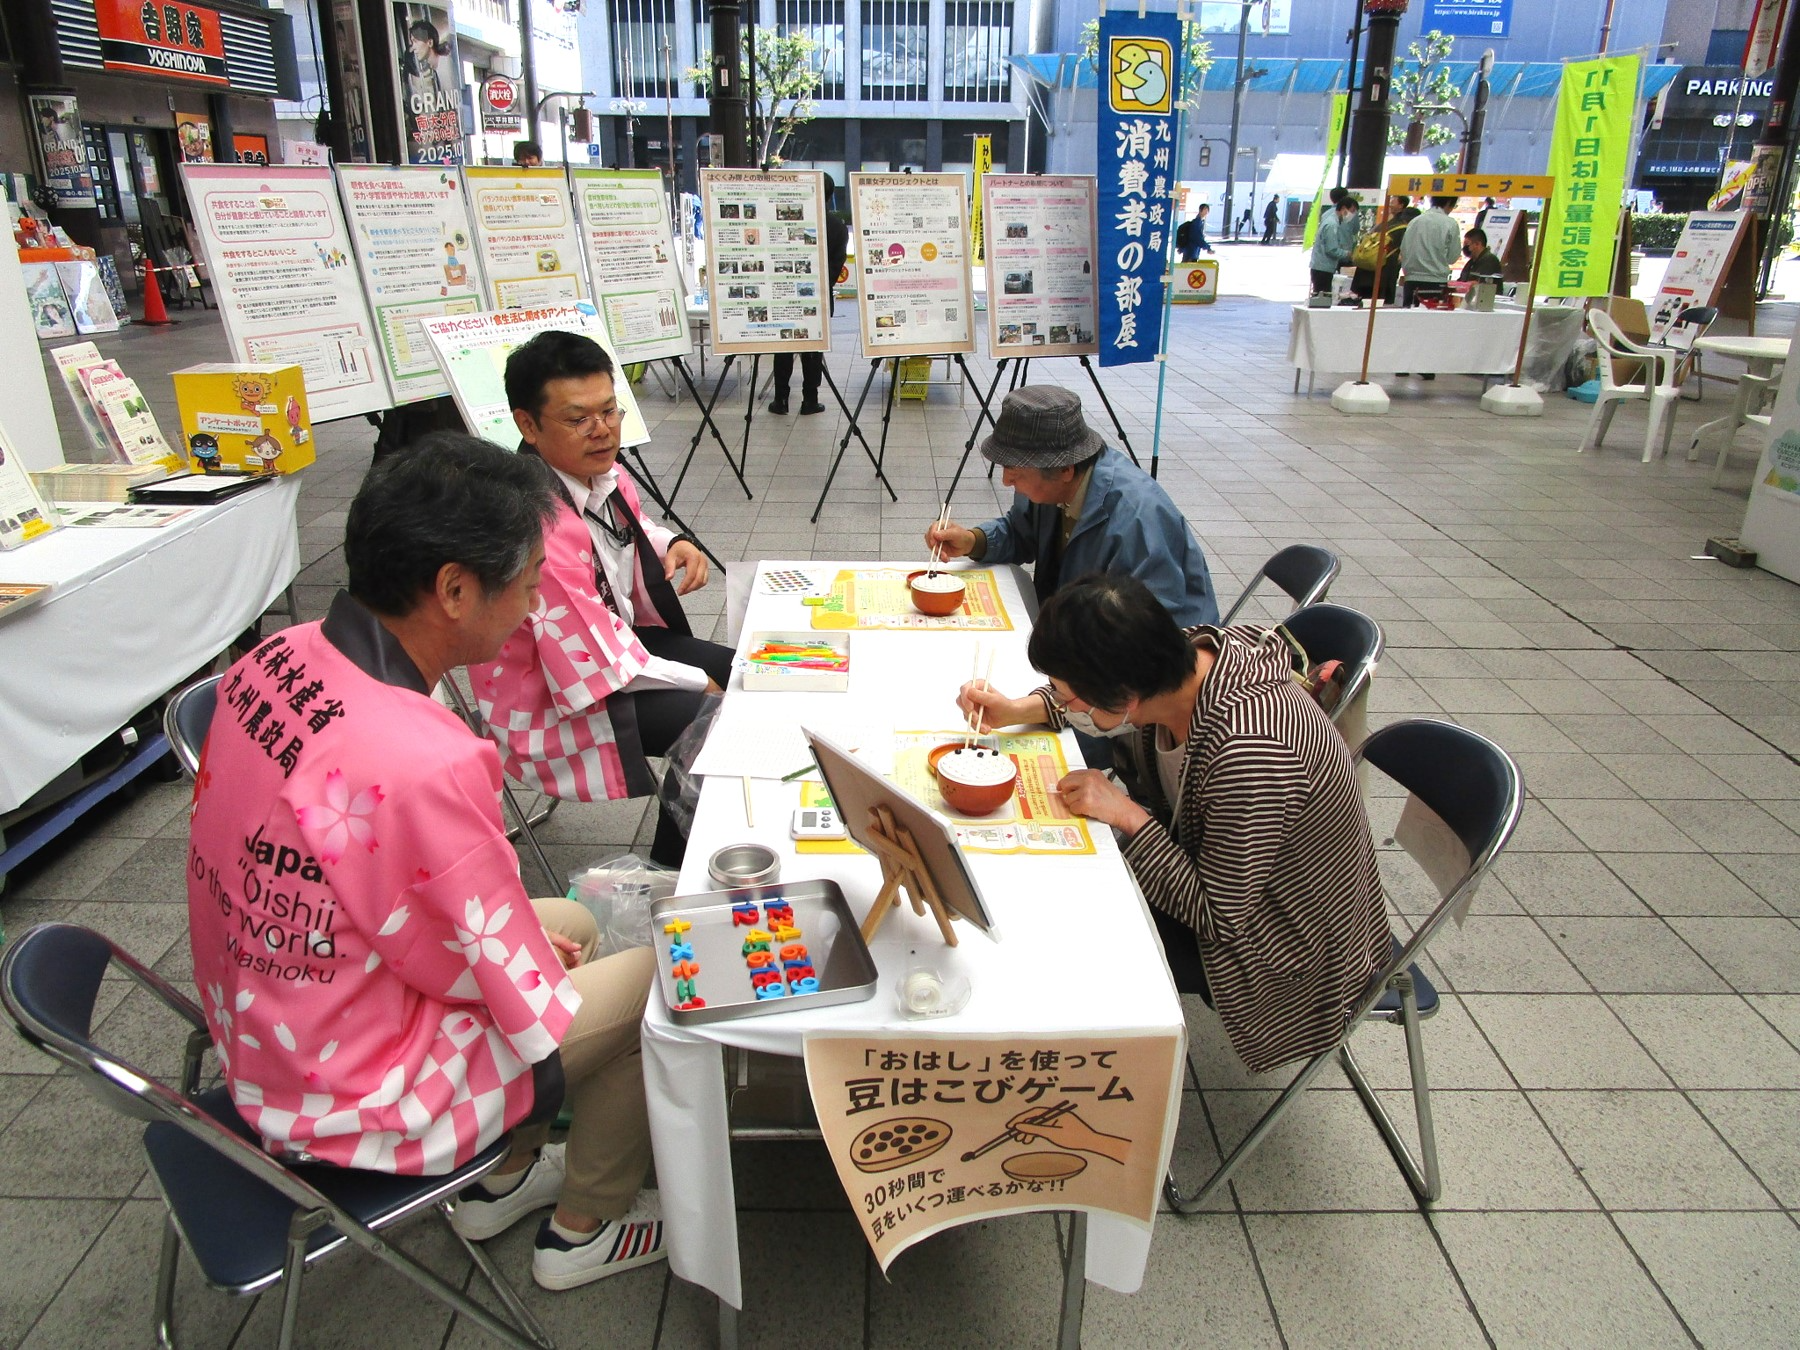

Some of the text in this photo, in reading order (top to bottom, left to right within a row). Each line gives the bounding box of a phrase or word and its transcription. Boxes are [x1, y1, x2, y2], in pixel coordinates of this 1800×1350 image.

[141, 1, 204, 48] 吉野家
[147, 48, 206, 73] YOSHINOYA
[489, 89, 512, 101] 消火栓
[1686, 79, 1773, 96] PARKING
[858, 177, 939, 187] 農業女子プロジェクトとは
[1147, 119, 1171, 252] 九州農政局
[1408, 178, 1535, 193] 計量コーナー
[1113, 120, 1152, 350] 消費者の部屋
[199, 416, 259, 429] アンケートボックス
[245, 824, 331, 886] Japa
[190, 844, 205, 881] to
[208, 866, 232, 917] the
[864, 1049, 1118, 1073] 「おはし」を使って
[845, 1075, 1135, 1117] 豆はこびゲーム
[864, 1167, 946, 1214] 30秒間で
